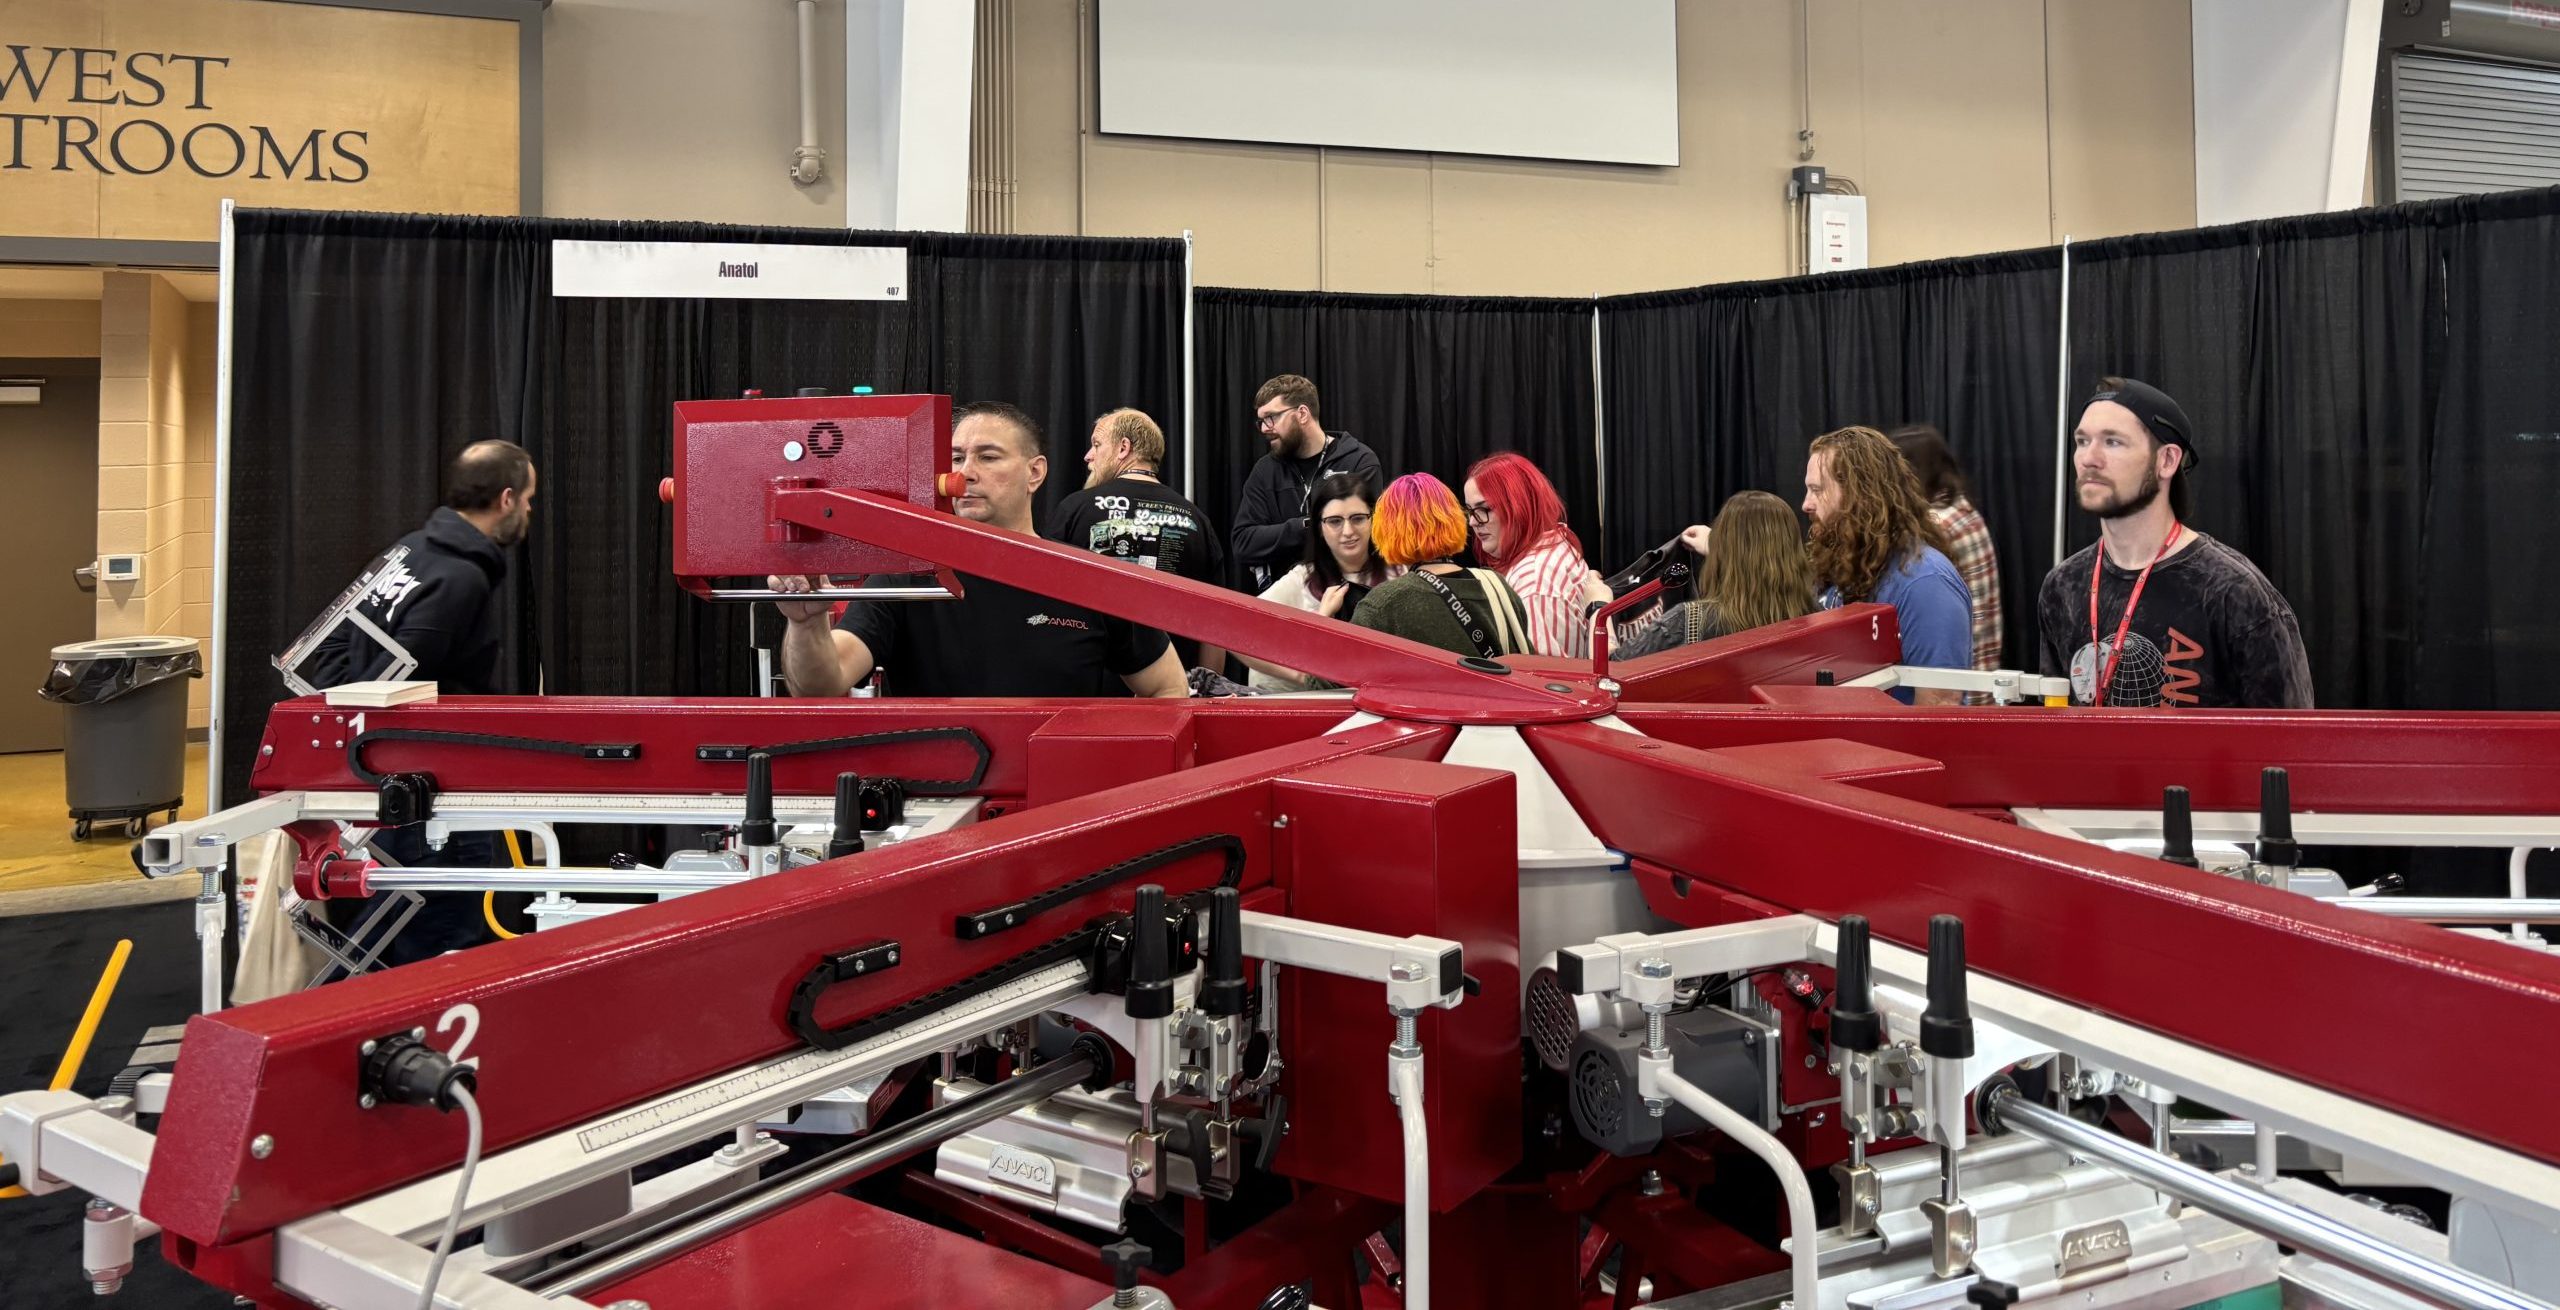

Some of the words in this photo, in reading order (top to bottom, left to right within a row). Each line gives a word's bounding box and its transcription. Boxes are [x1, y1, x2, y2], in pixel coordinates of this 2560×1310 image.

[0, 44, 229, 110] WEST
[718, 261, 758, 278] Anatol
[1108, 509, 1127, 520] FEST
[1133, 509, 1191, 528] Lovers
[1418, 570, 1450, 594] NIGHT
[1447, 593, 1472, 626] TOUR
[1048, 617, 1089, 630] ANATOL
[1872, 615, 1879, 640] 5
[349, 712, 365, 737] 1
[436, 1003, 480, 1071] 2
[991, 1155, 1052, 1185] ANATOL
[2065, 1228, 2129, 1260] ANATOL
